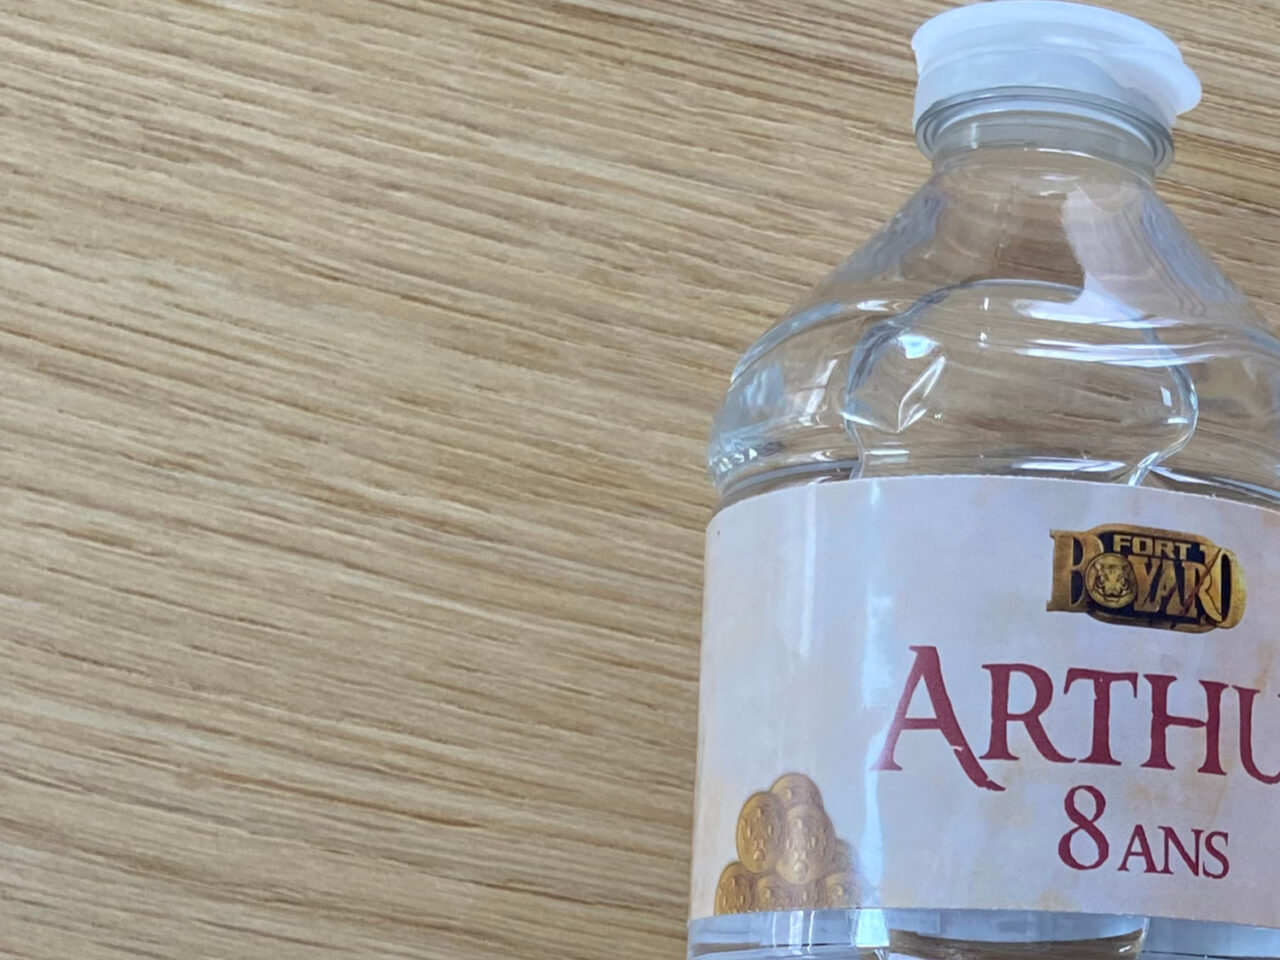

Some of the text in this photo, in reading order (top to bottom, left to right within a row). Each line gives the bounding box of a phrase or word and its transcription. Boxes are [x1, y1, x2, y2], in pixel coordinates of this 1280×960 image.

[1113, 534, 1192, 560] FORT
[1057, 785, 1231, 879] 8 ANS
